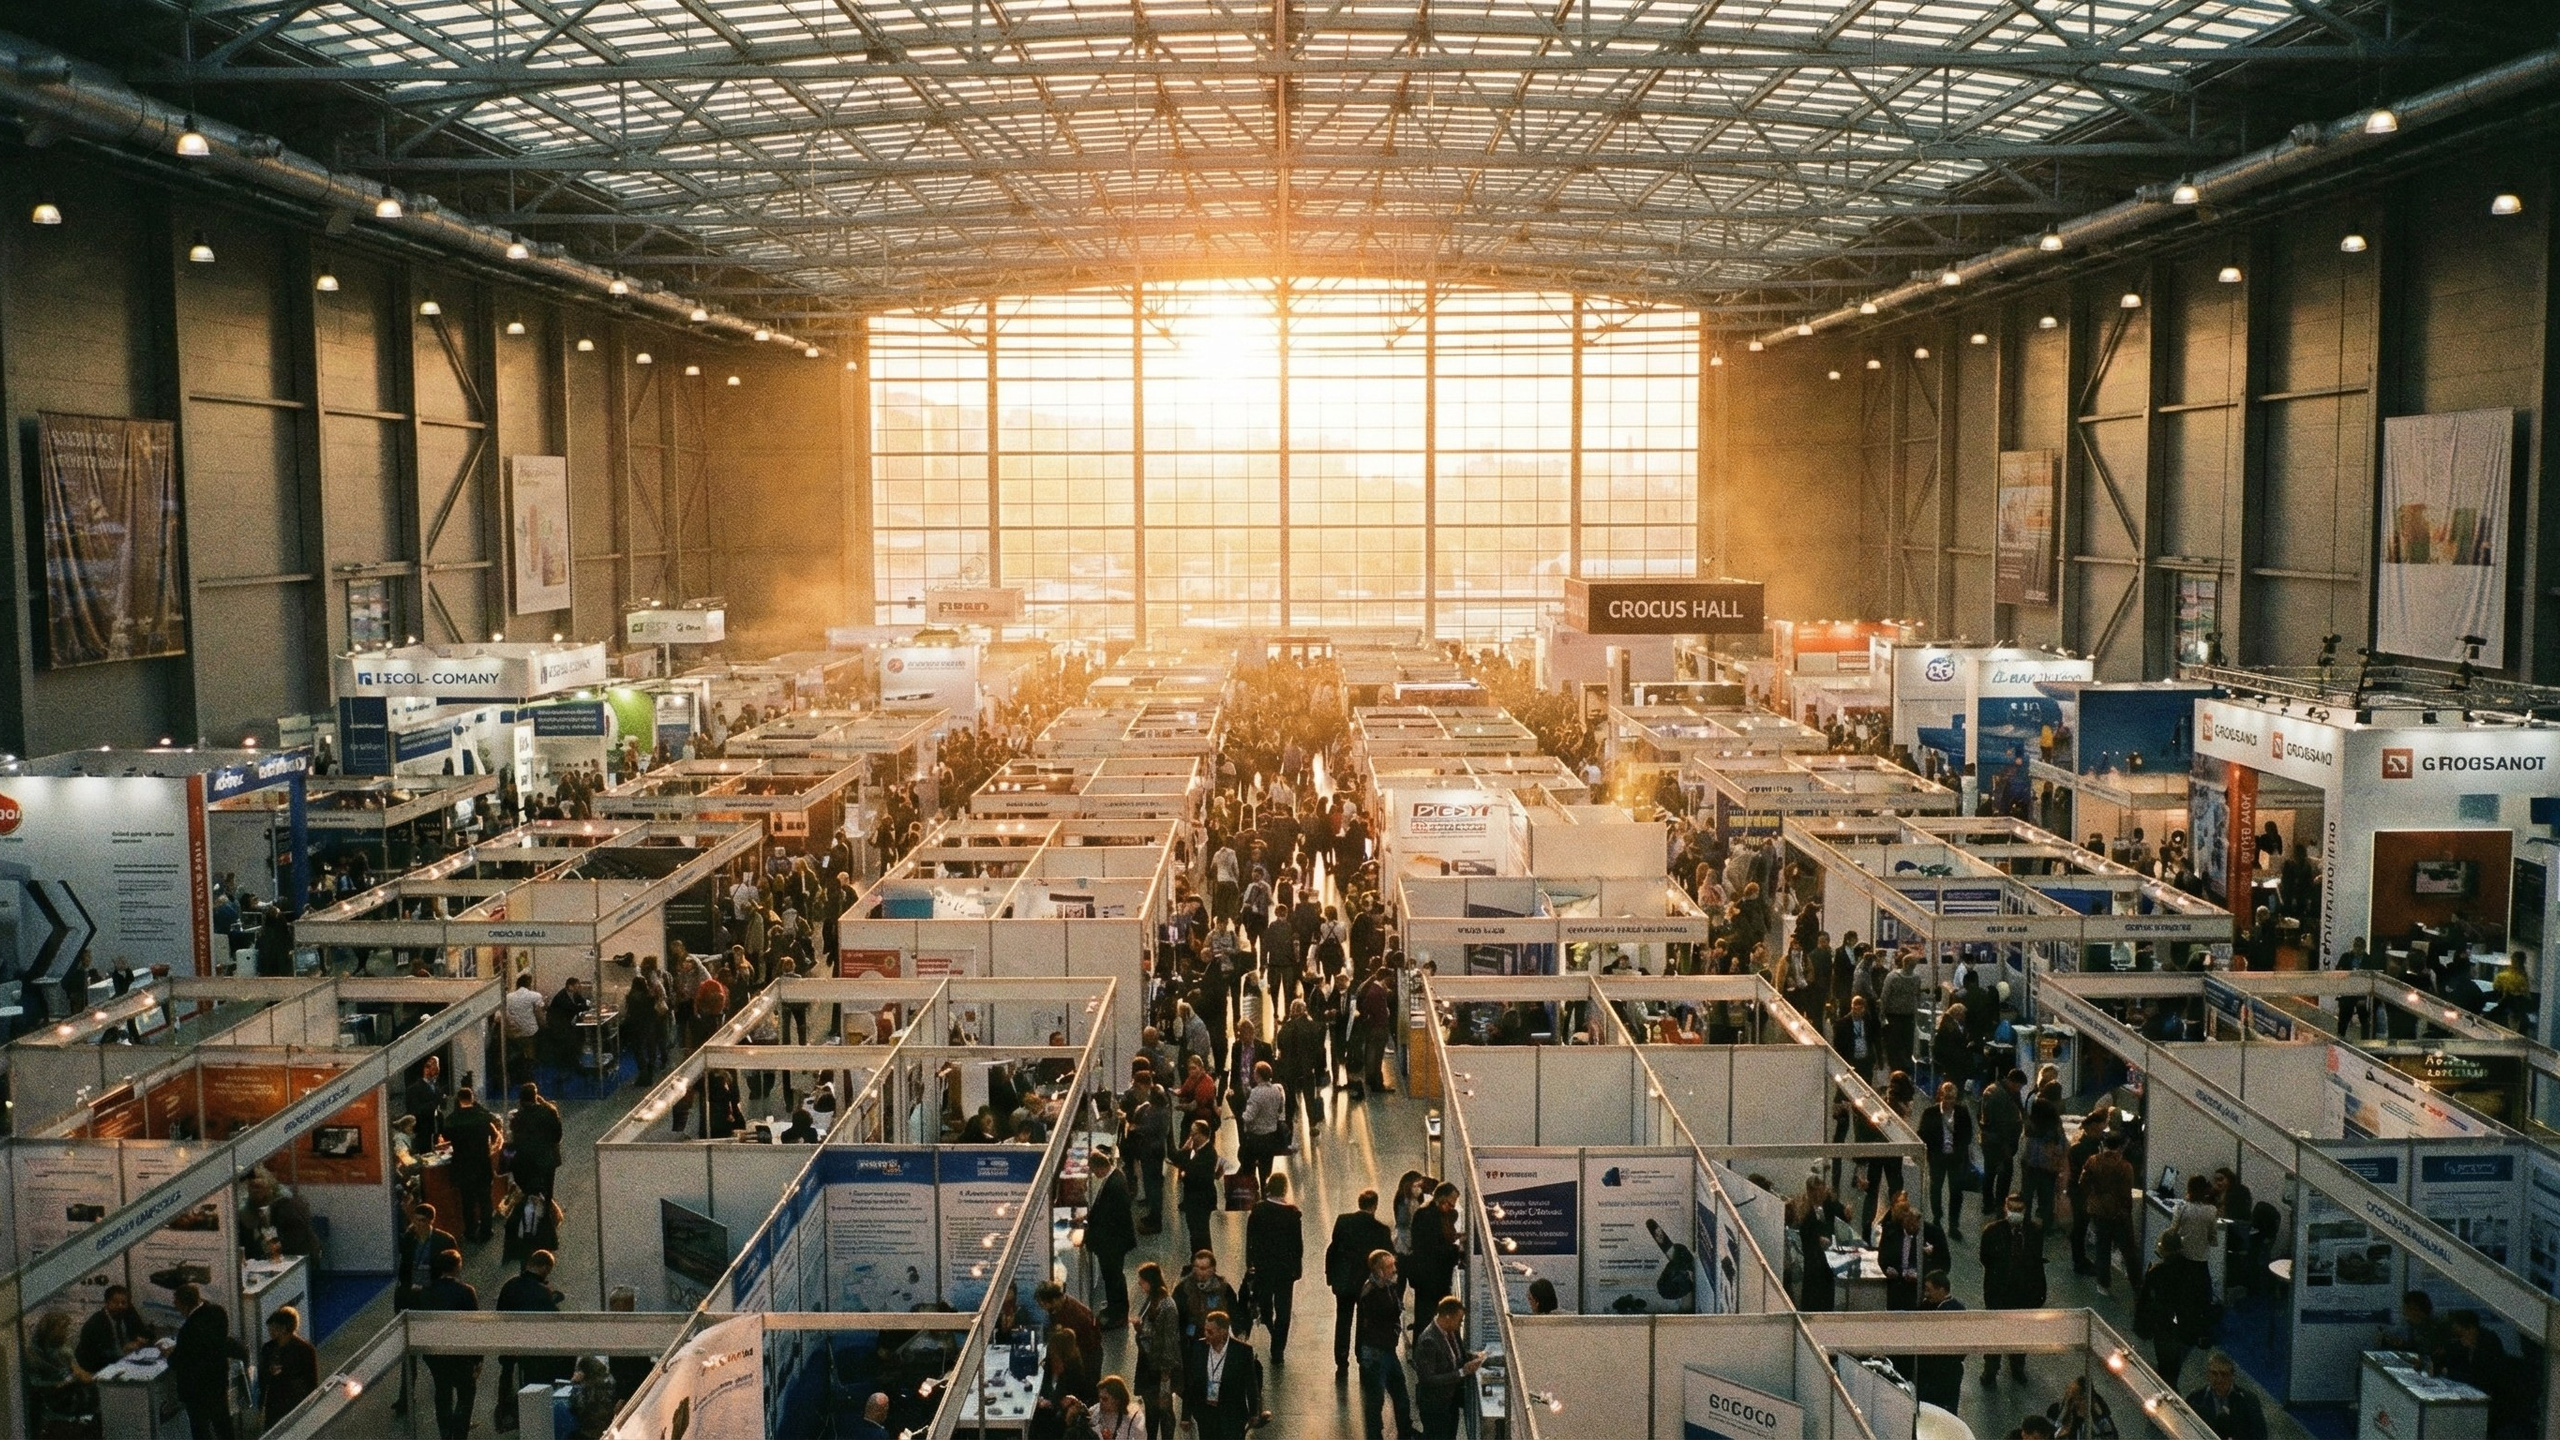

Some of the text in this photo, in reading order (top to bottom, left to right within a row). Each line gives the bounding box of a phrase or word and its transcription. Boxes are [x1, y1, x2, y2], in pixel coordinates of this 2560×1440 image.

[1608, 600, 1744, 619] CROCUS HALL
[432, 672, 499, 685] COMANY
